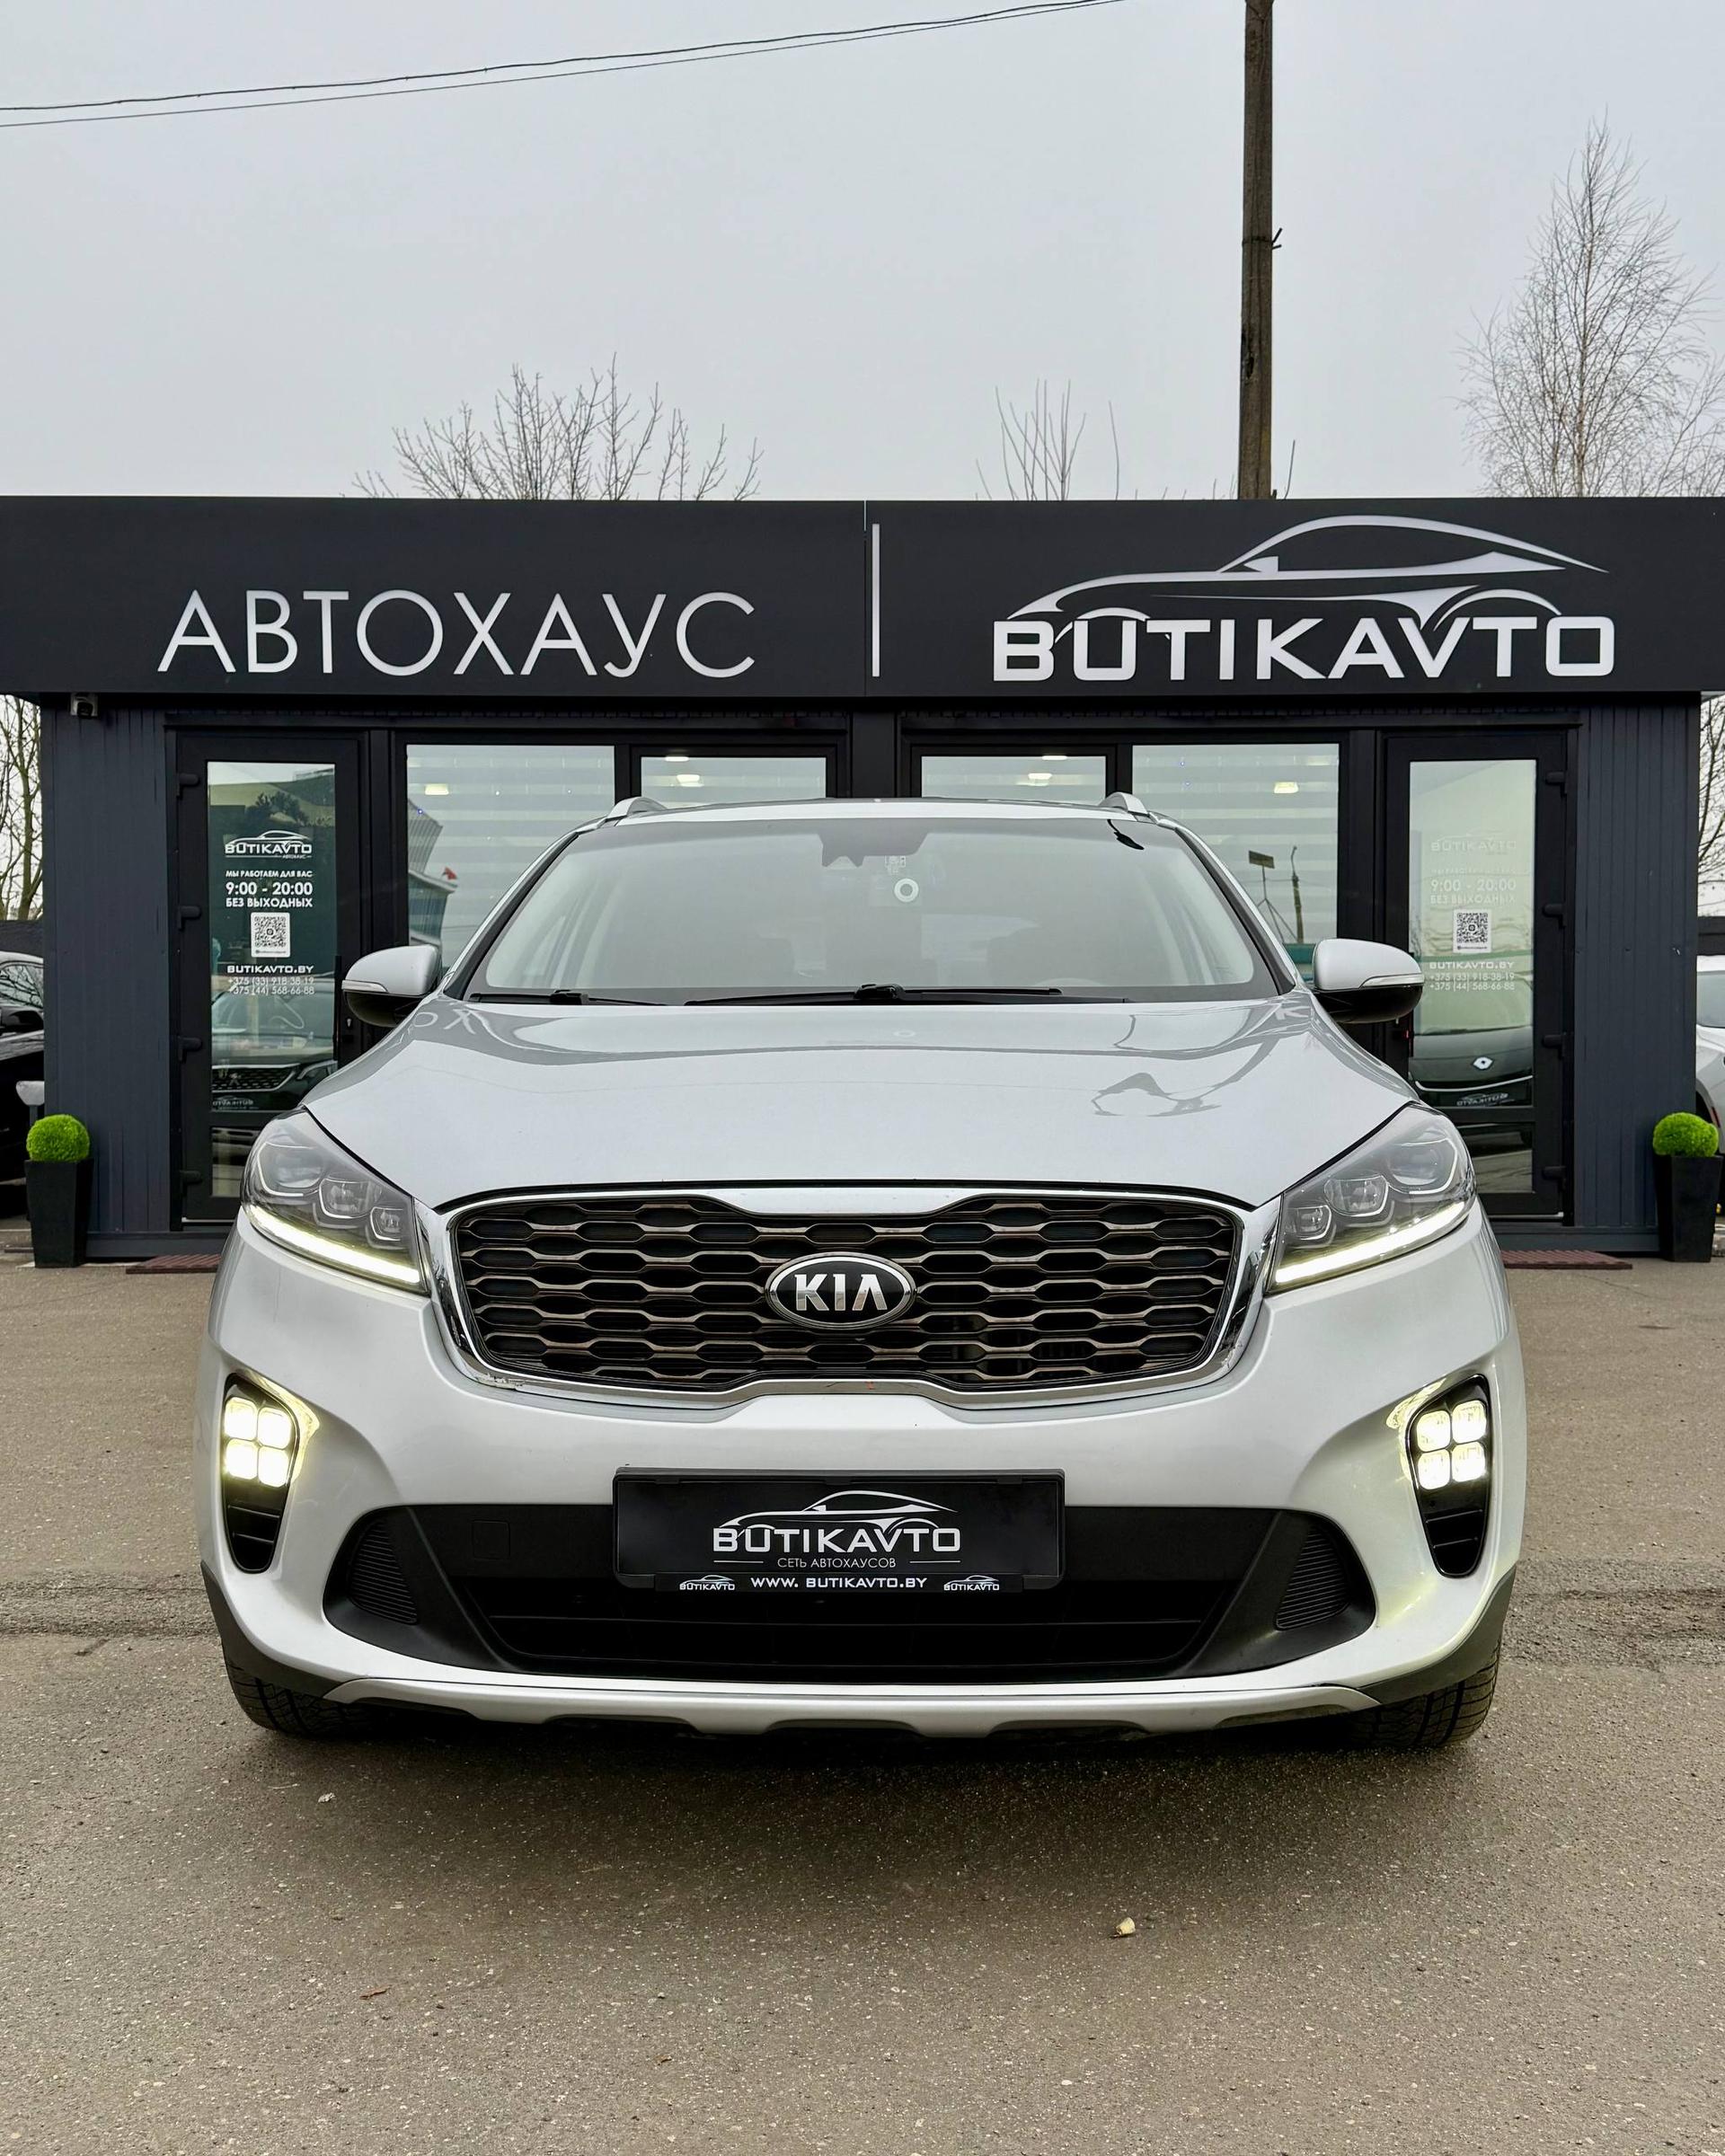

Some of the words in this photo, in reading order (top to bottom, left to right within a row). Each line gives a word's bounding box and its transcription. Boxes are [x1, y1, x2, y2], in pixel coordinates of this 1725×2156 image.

[157, 588, 755, 678] АВТОХАУС
[993, 616, 1614, 682] BUTIKAVTO
[225, 843, 313, 854] BUTIKAVTO
[226, 870, 239, 878] МЫ
[240, 870, 279, 878] РАБОТАЕМ
[279, 870, 296, 879] ДЛЯ
[296, 870, 313, 878] ВАС
[226, 882, 257, 896] 9:00
[272, 882, 313, 896] 20:00
[1430, 879, 1461, 891] 9:00
[1476, 879, 1517, 891] 20:00
[226, 897, 244, 908] БЕЗ
[247, 897, 313, 909] ВЫХОДНЫХ
[227, 965, 314, 974] BUTIKAVTO.BY
[1429, 961, 1515, 970] BUTIKAVTO.BY
[794, 1274, 888, 1312] KIA
[713, 1527, 960, 1553] BUTIKAVTO
[777, 1558, 807, 1568] СЕТЬ
[810, 1557, 897, 1569] АВТОХАУСОВ
[679, 1582, 736, 1591] BUTIKAVTO
[806, 1577, 927, 1588] BUTIKAVTO.BY
[943, 1583, 1000, 1591] BUTIKAVTO
